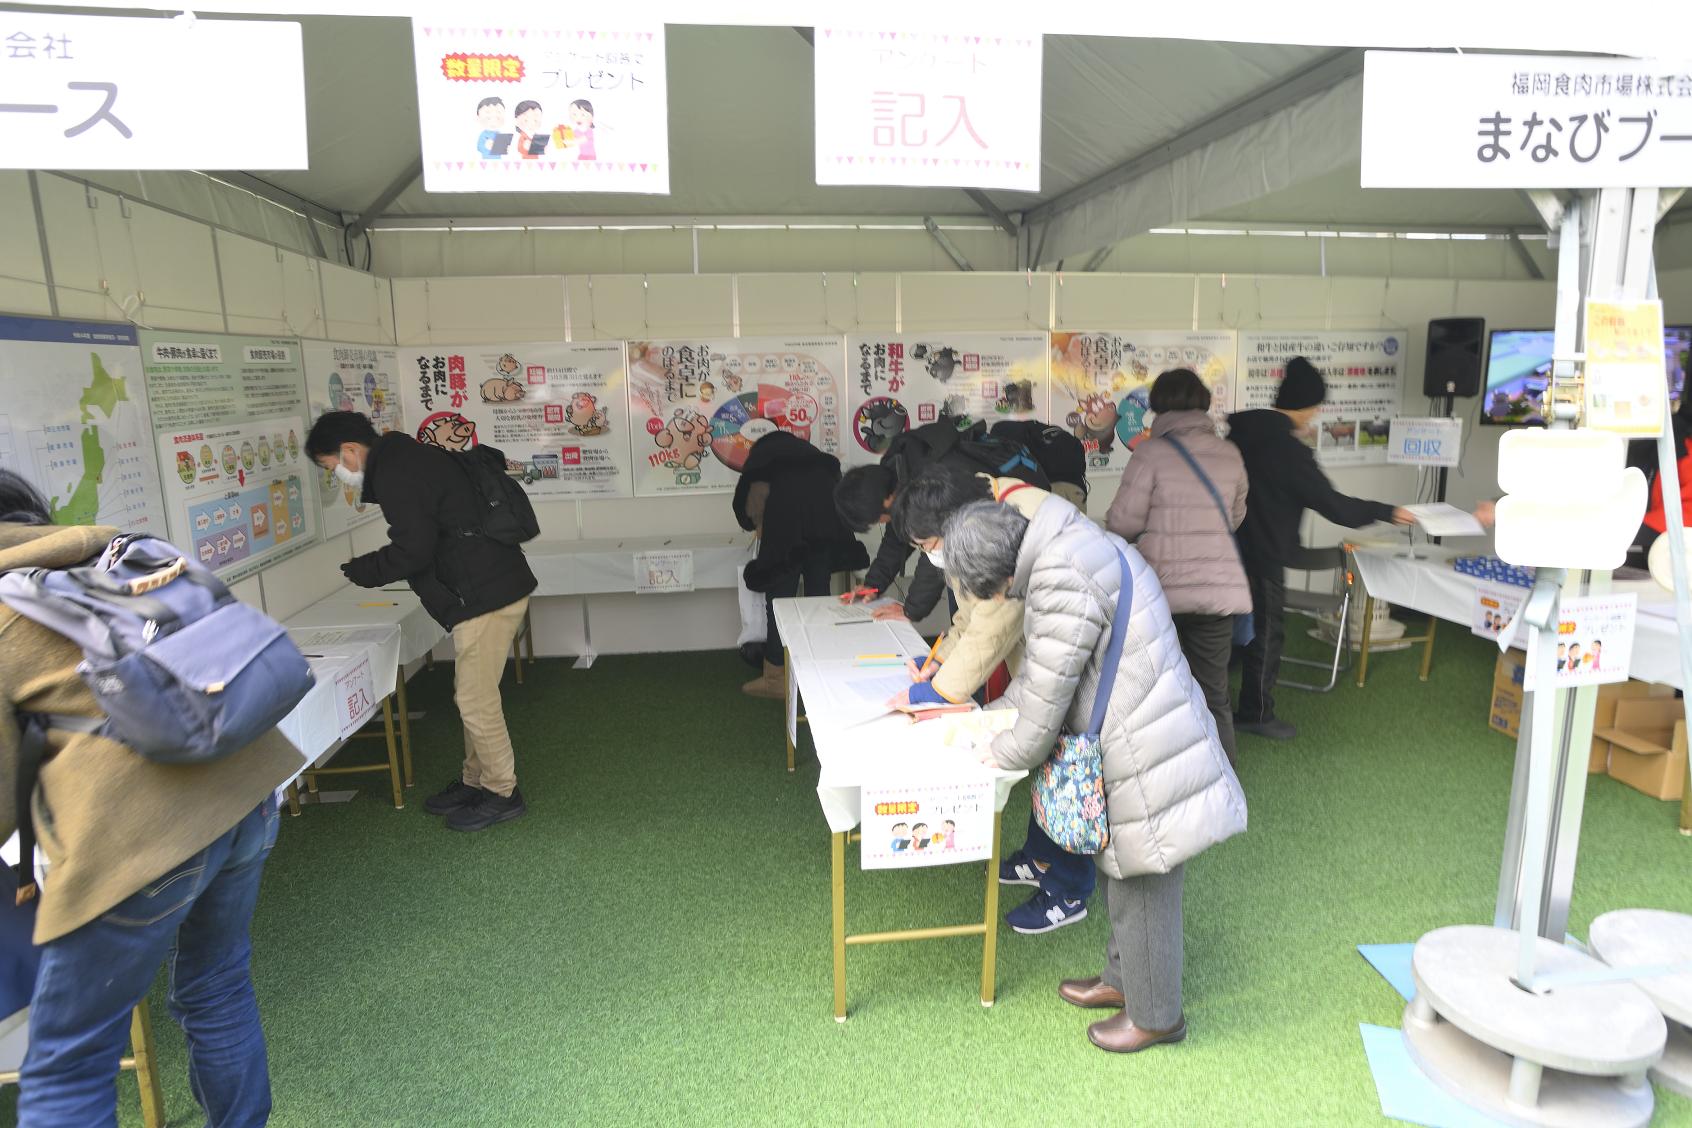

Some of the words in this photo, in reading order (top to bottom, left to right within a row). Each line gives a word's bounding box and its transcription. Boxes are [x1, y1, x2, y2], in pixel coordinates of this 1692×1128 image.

[5, 31, 74, 60] 会社
[446, 57, 520, 79] 数量限定
[871, 91, 989, 149] 記入
[1477, 109, 1692, 163] まなびブー
[677, 345, 697, 399] 食卓に
[697, 344, 710, 382] お肉が
[859, 343, 873, 396] なるまで
[874, 343, 886, 381] お肉に
[887, 343, 905, 393] 和牛が
[1095, 337, 1109, 387] 食卓に
[1110, 336, 1122, 370] お肉が
[416, 356, 433, 411] なるまで
[432, 356, 447, 396] お肉に
[447, 355, 467, 408] 肉豚が
[1404, 439, 1441, 456] 回収
[649, 569, 680, 585] 記入
[347, 688, 370, 720] 記入
